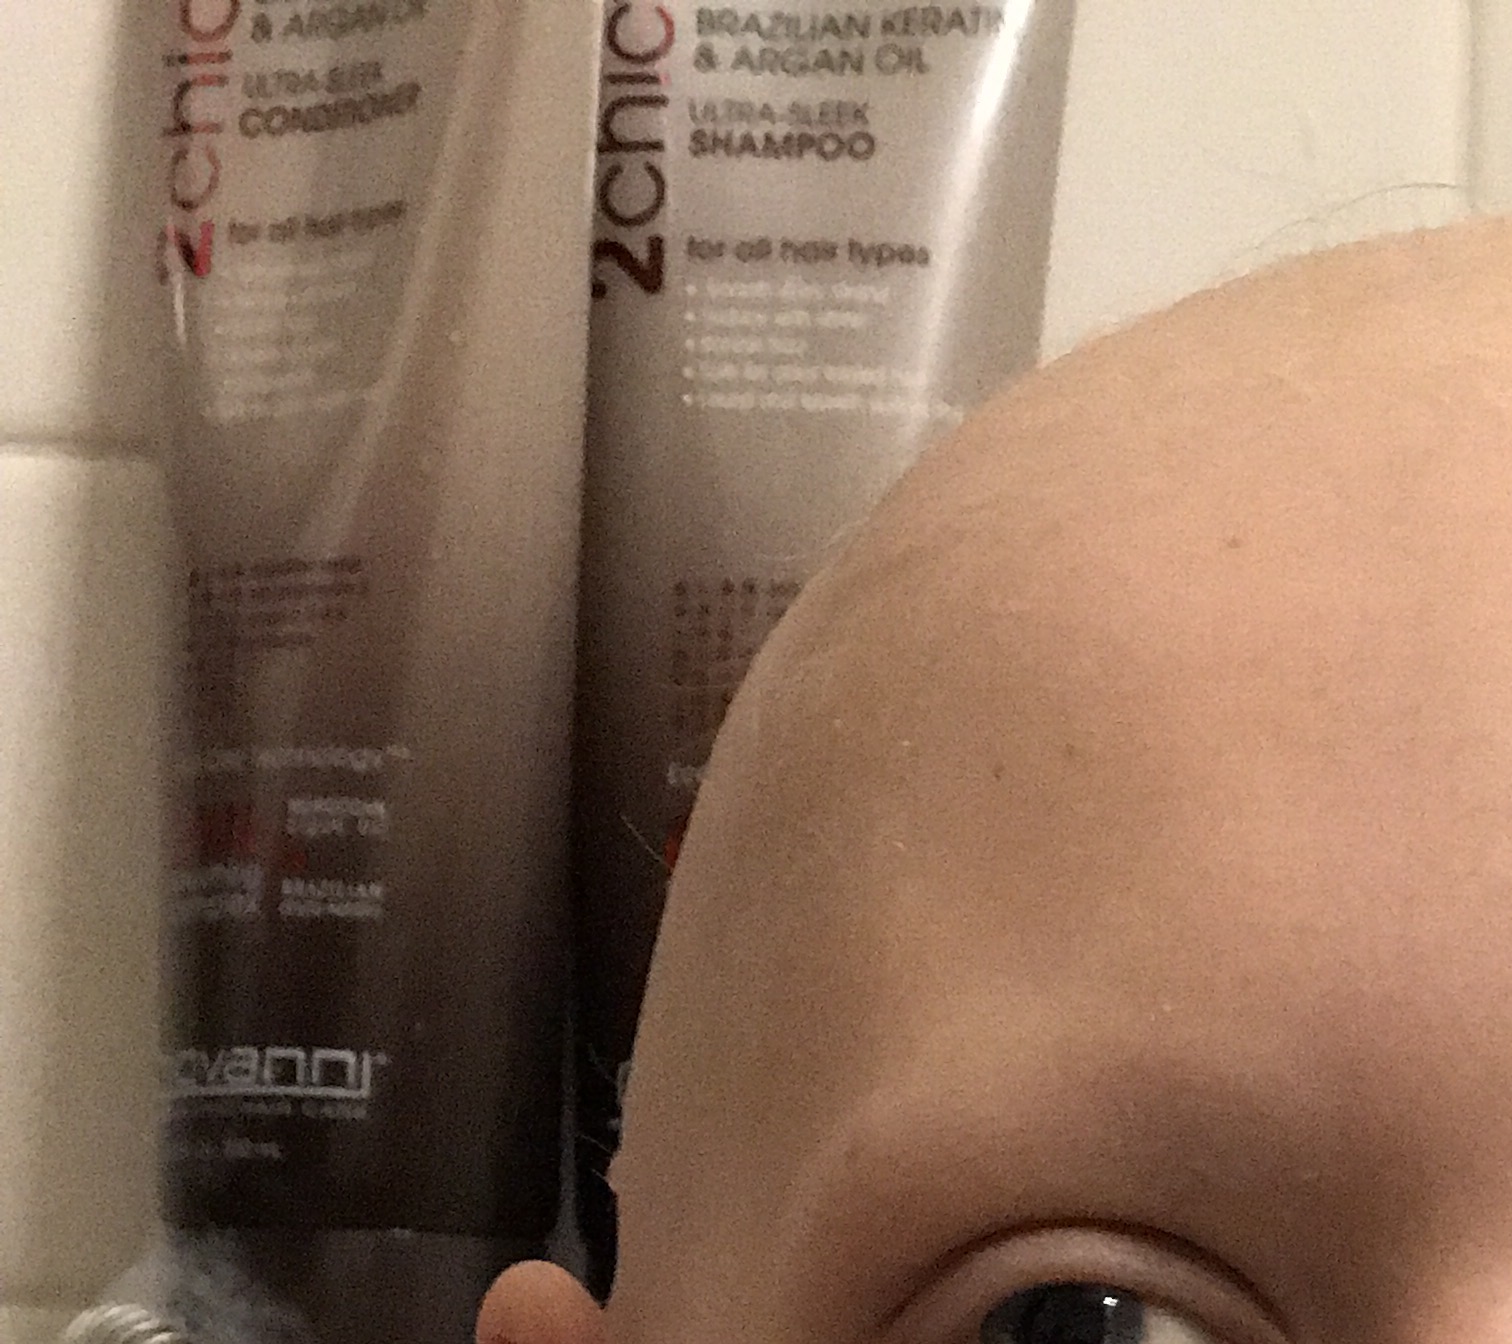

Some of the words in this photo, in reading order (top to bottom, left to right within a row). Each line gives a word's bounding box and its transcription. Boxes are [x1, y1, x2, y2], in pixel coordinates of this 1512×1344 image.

[696, 7, 871, 40] BRAZILIAN
[694, 42, 717, 74] &
[731, 45, 864, 76] ARGAN
[875, 43, 930, 75] OIL
[591, 2, 676, 295] 2chic
[688, 128, 876, 161] SHAMPOO
[686, 235, 726, 262] for
[734, 238, 772, 263] all
[780, 237, 839, 264] hair
[847, 237, 930, 268] types
